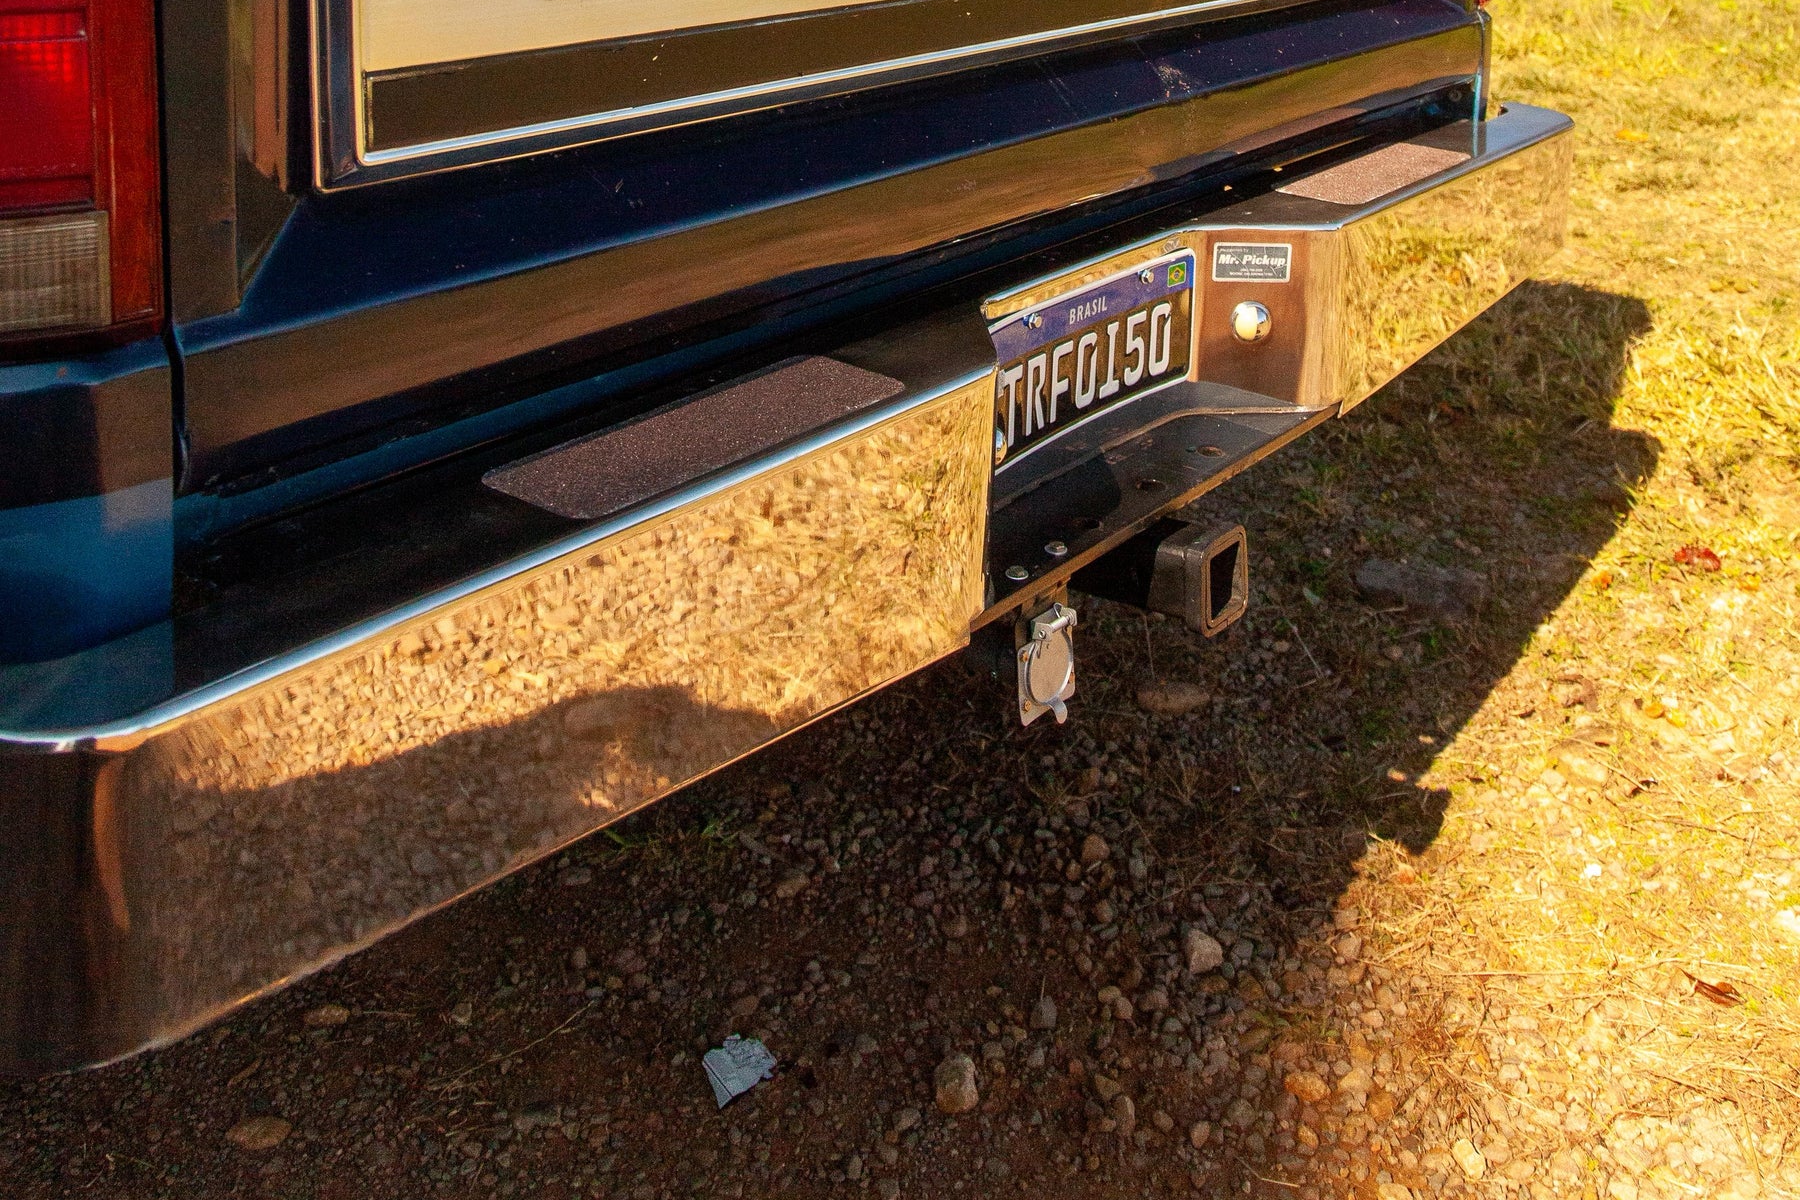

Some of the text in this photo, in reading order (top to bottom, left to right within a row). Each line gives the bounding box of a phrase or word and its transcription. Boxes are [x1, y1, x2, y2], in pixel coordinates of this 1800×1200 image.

[1218, 254, 1287, 267] Mr. Pickup
[1068, 295, 1109, 325] BRASIL
